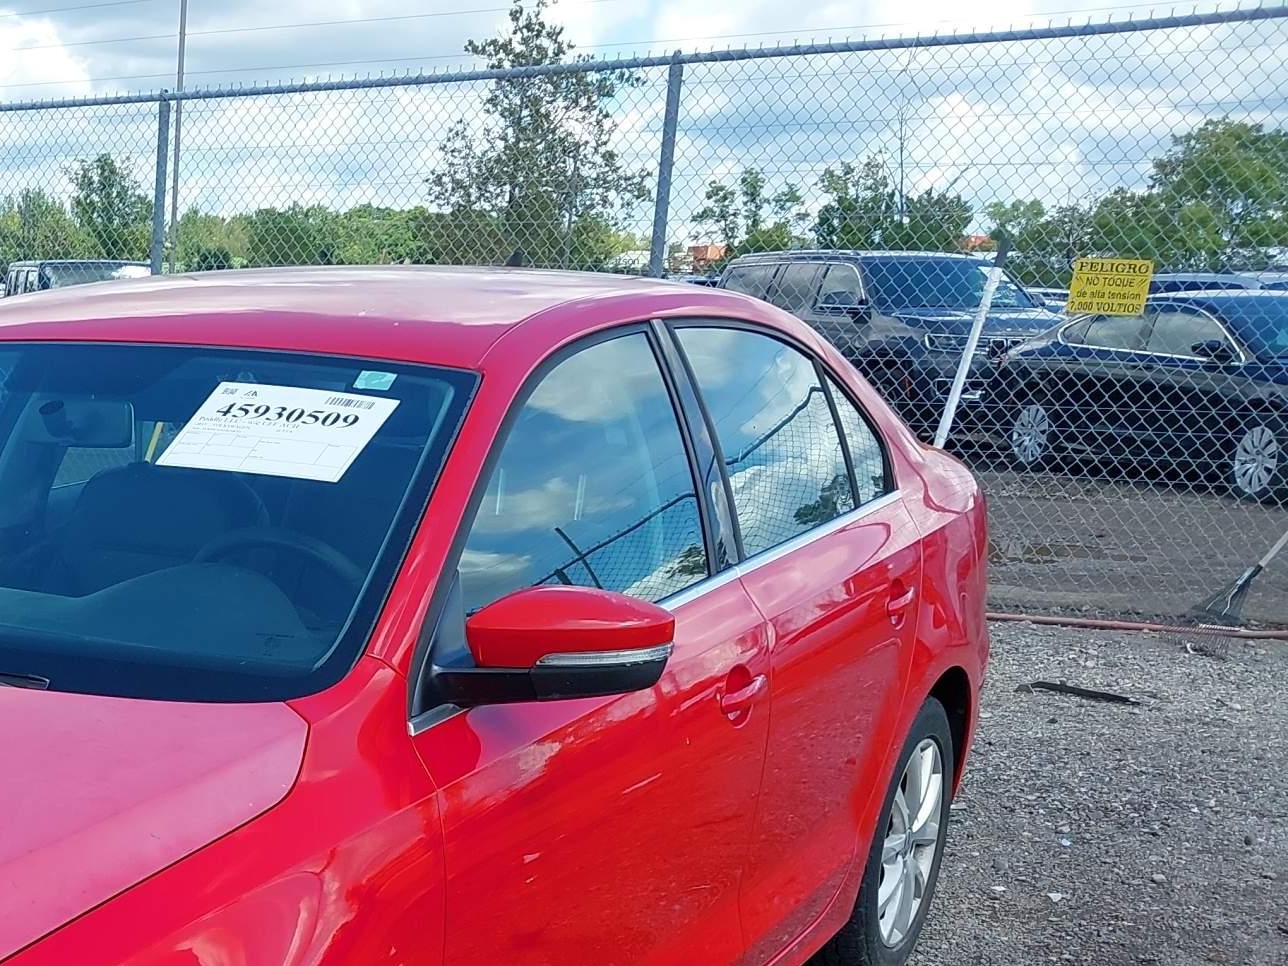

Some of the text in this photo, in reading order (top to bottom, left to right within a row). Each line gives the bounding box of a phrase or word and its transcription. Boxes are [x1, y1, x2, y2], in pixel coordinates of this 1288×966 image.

[1078, 261, 1150, 274] PELIGRO
[1085, 276, 1136, 288] NO TOQUE
[1076, 289, 1087, 298] de
[1089, 289, 1105, 299] alta
[1096, 301, 1142, 314] VOLTIOS
[215, 401, 361, 429] 45930509
